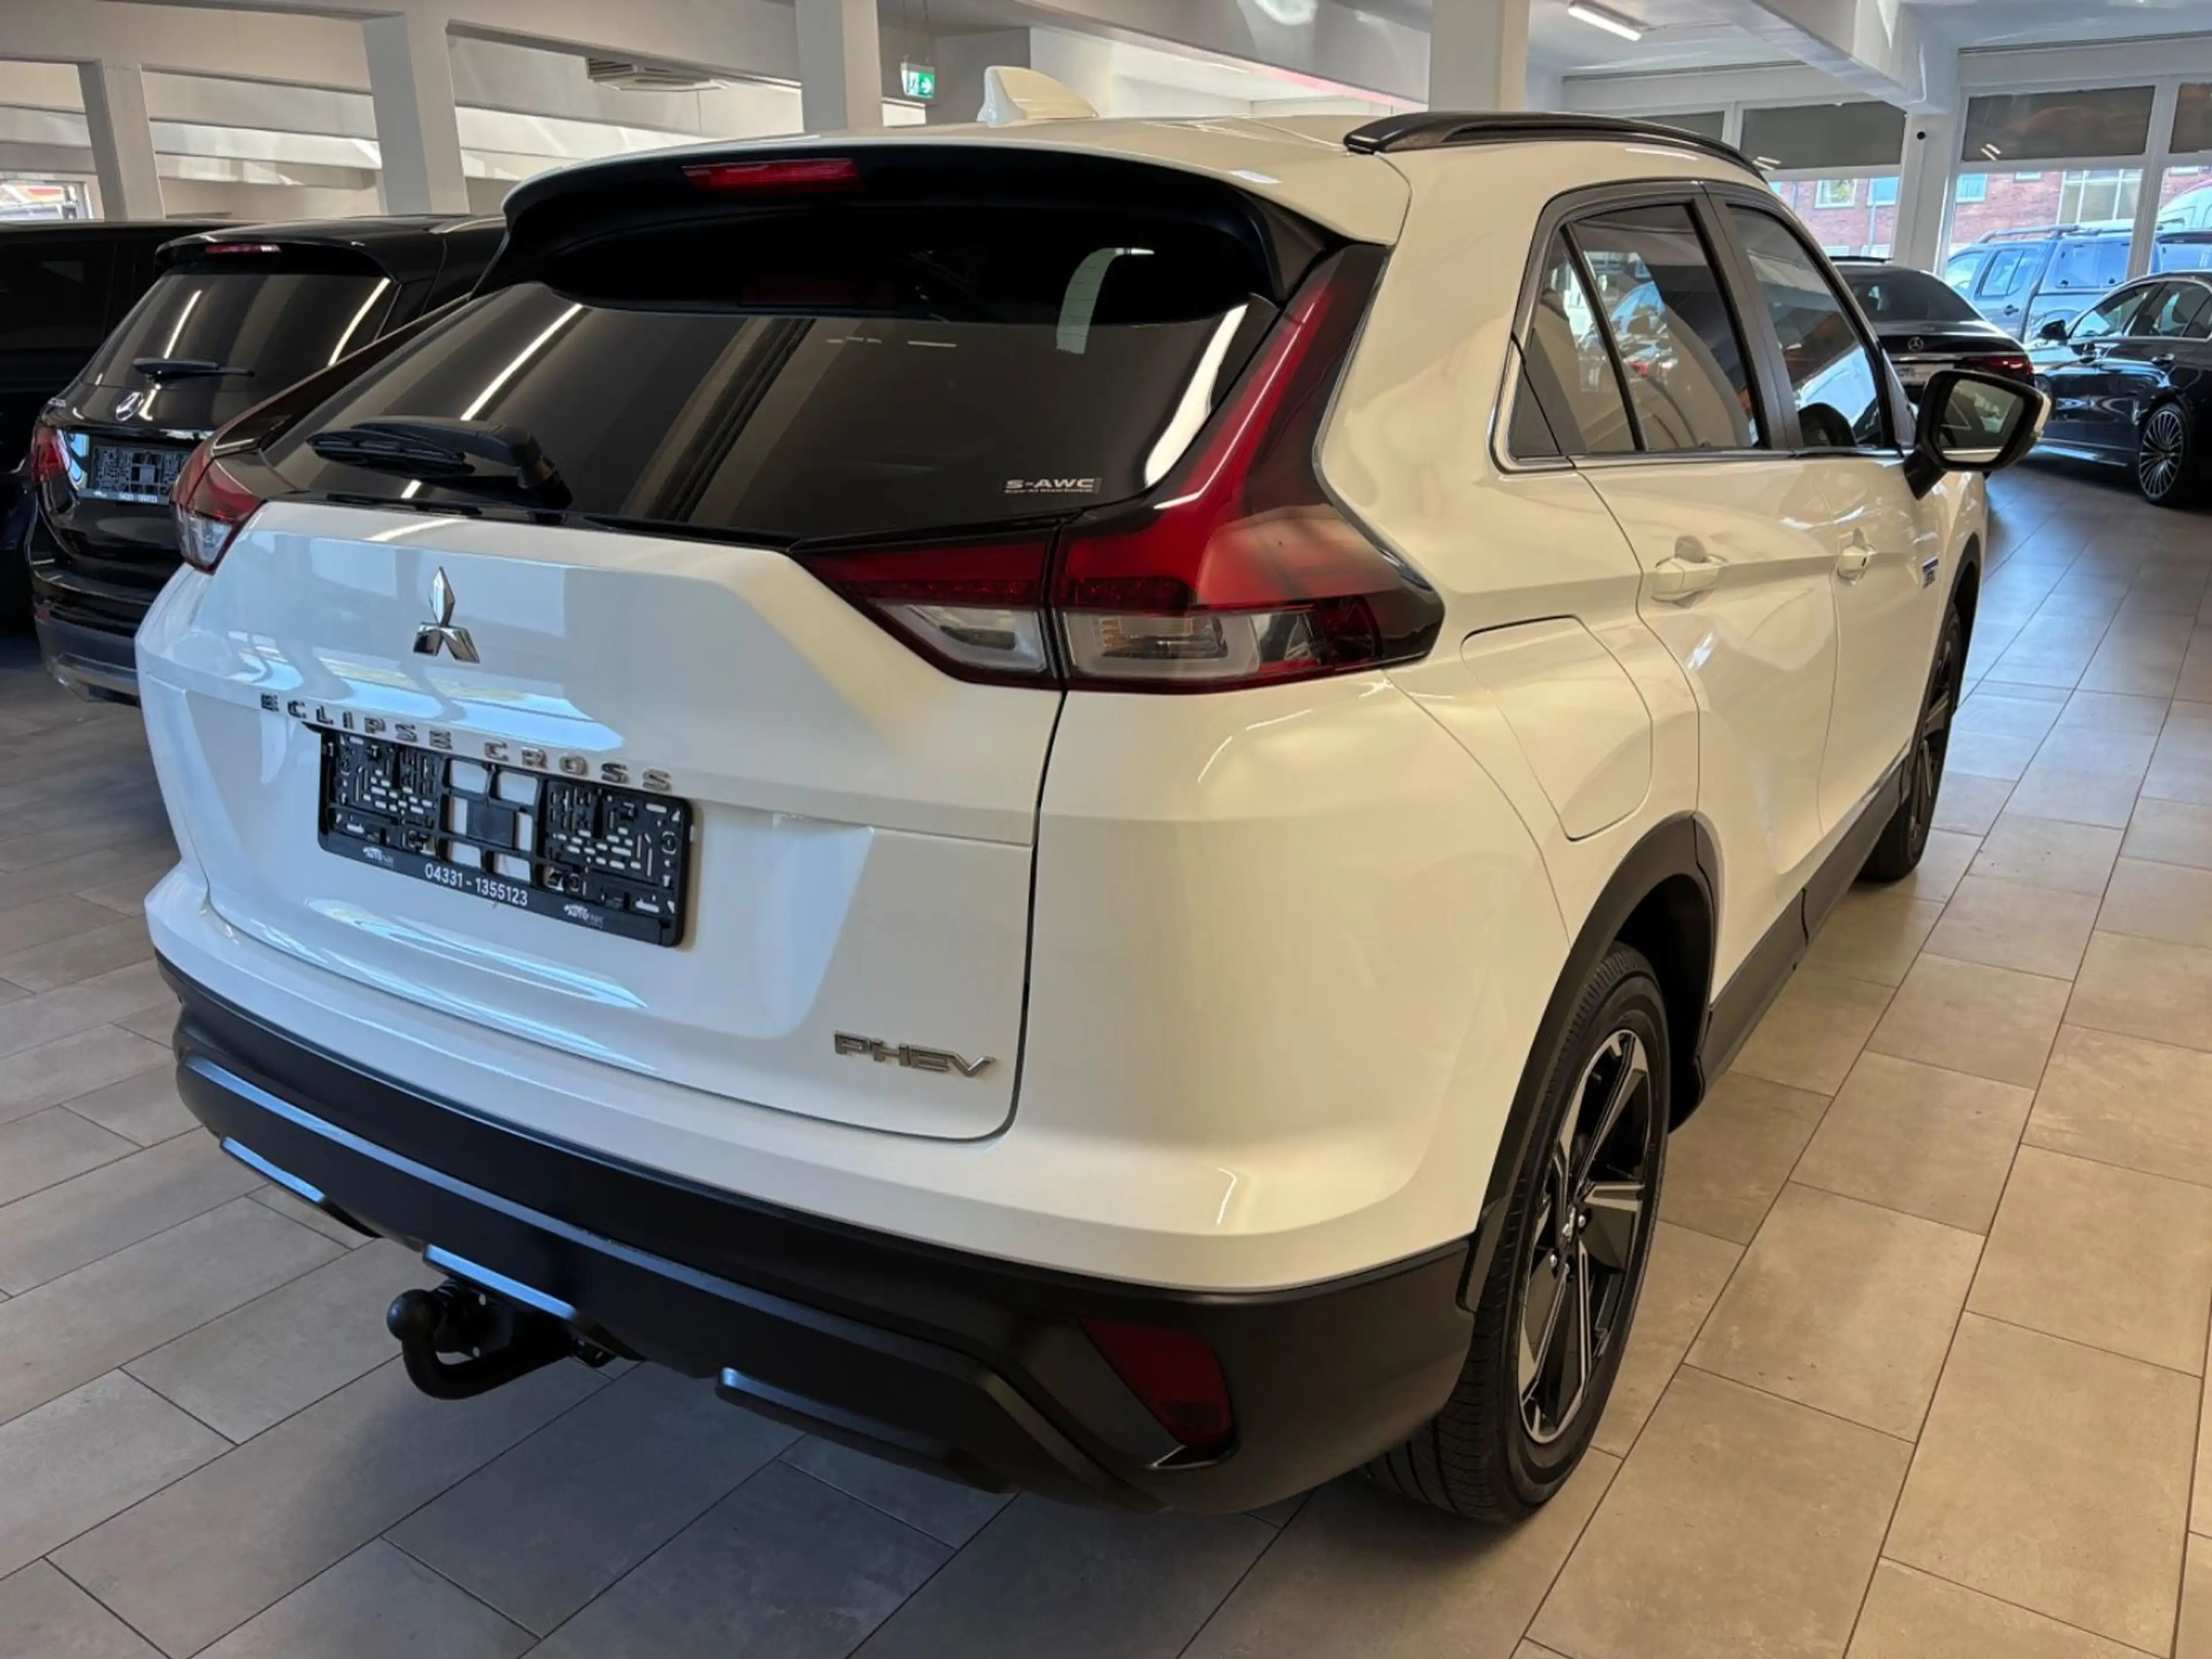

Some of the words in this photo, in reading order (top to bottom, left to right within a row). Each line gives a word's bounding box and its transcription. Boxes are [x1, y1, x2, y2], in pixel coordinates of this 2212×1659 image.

[1006, 478, 1094, 488] S-AWC
[261, 693, 453, 749] ECLIPSE
[484, 740, 672, 793] CROSS
[425, 862, 463, 888] 04331
[475, 877, 528, 907] 1355123
[834, 1030, 997, 1078] PHEV
